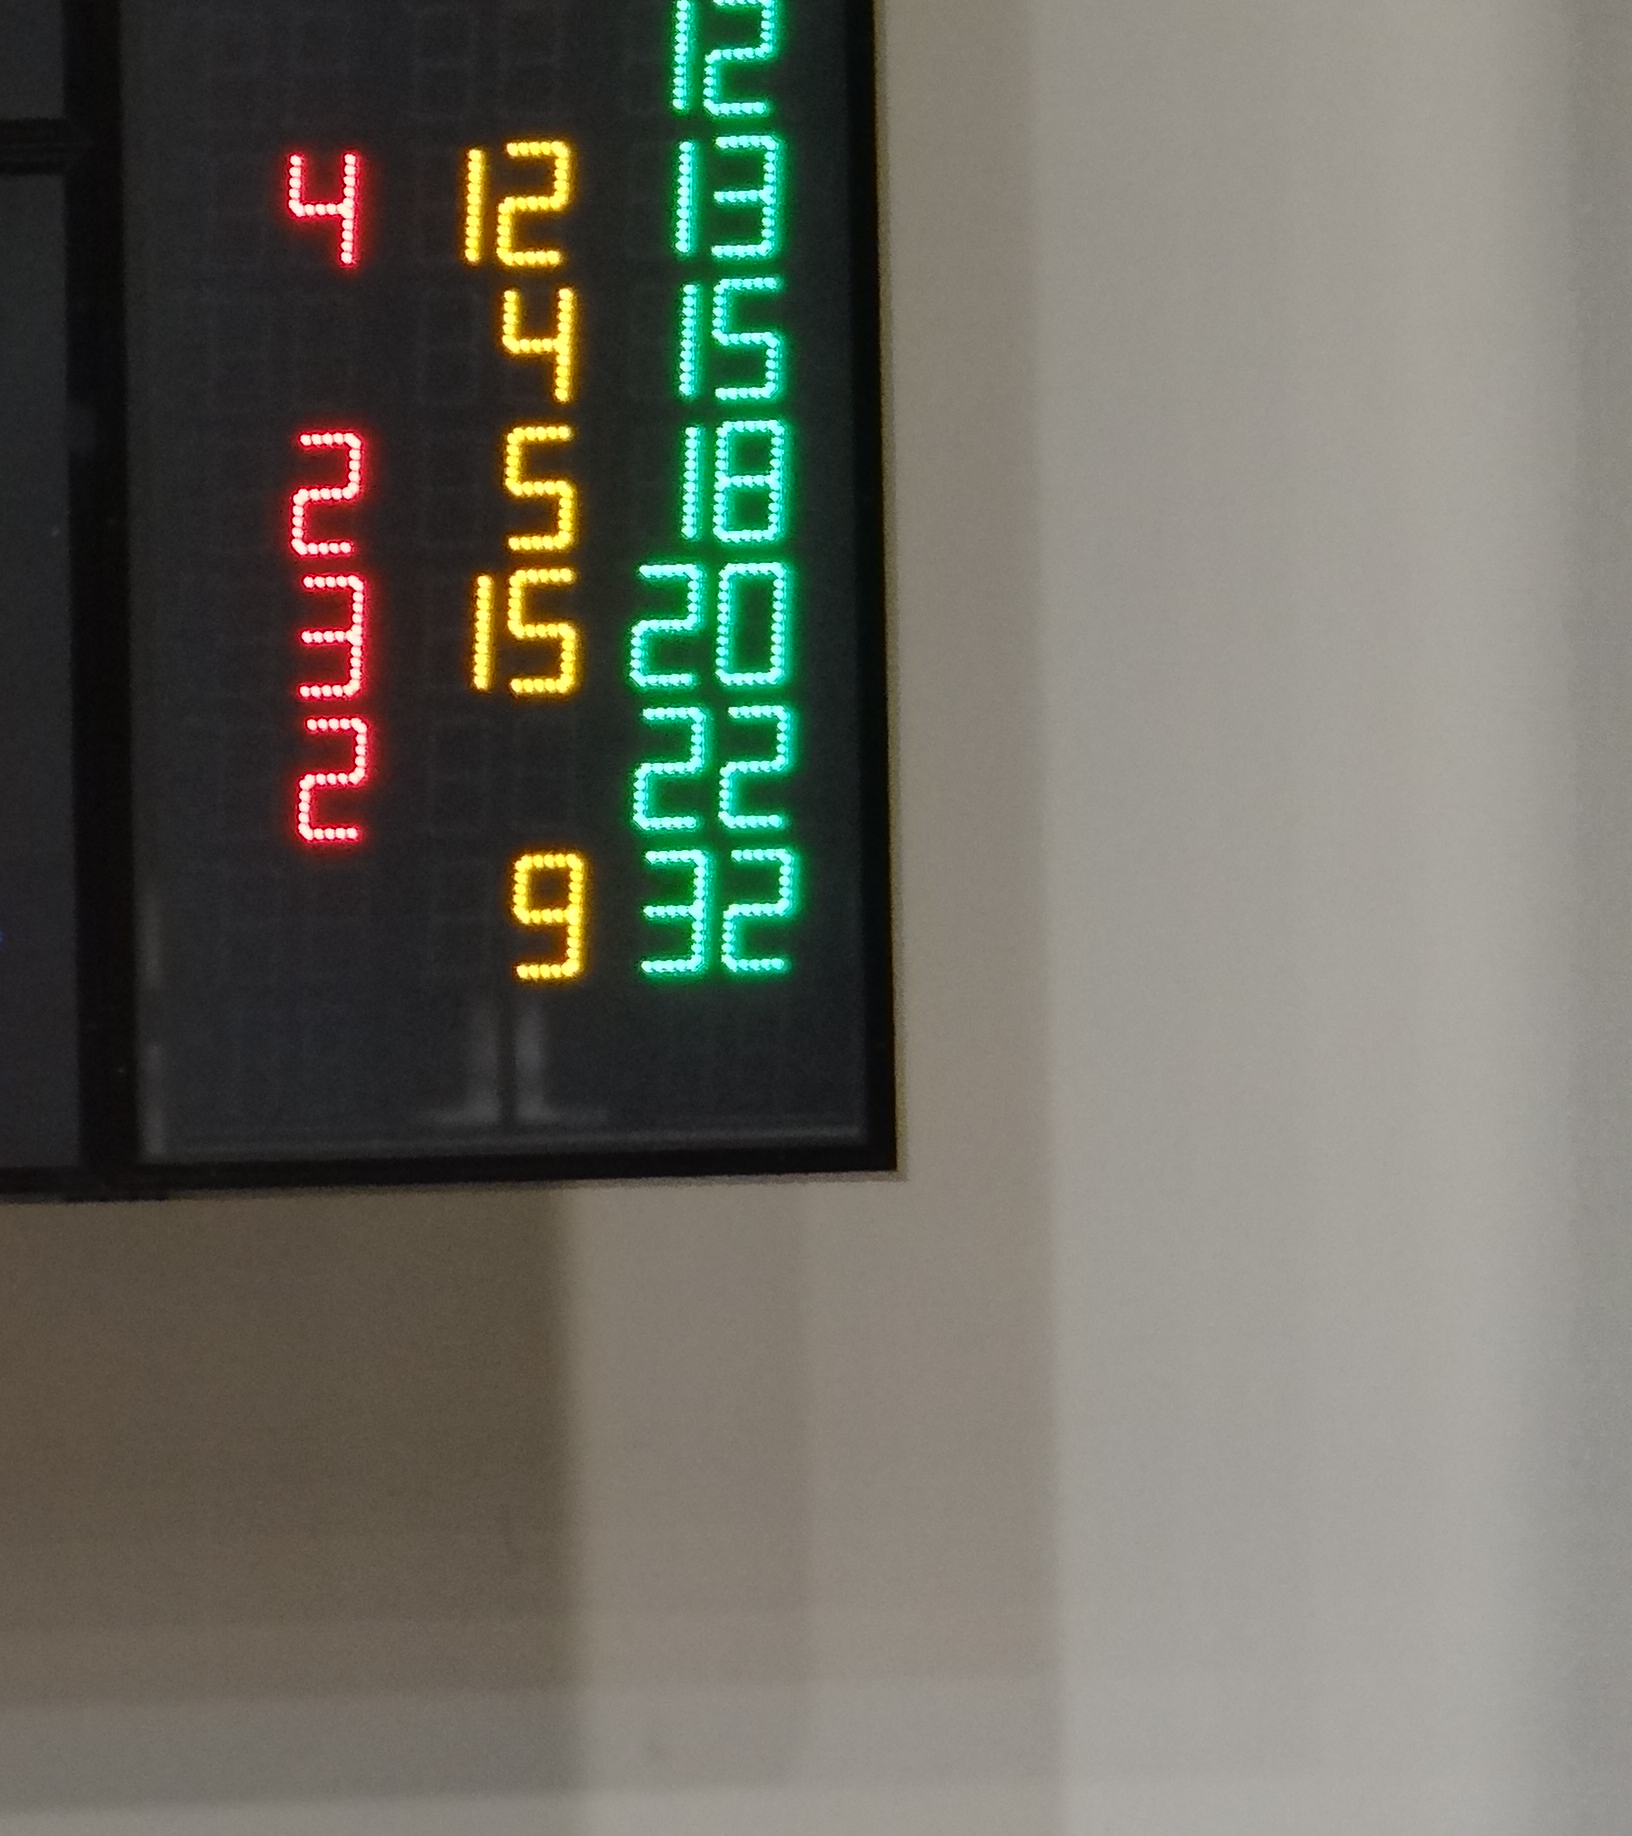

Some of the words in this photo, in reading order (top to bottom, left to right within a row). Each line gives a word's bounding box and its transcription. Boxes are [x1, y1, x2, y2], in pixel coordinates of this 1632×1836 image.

[286, 150, 364, 269] 4
[463, 139, 572, 269] 12
[673, 133, 784, 262] 13
[500, 286, 576, 404] 4
[677, 276, 784, 403] 15
[288, 427, 368, 561] 2
[503, 424, 577, 553] 5
[679, 418, 789, 547] 18
[298, 570, 371, 703] 3
[472, 566, 580, 696] 15
[627, 560, 792, 689] 20
[296, 712, 374, 846] 2
[631, 703, 795, 833] 22
[510, 851, 586, 981] 9
[639, 846, 800, 975] 32
